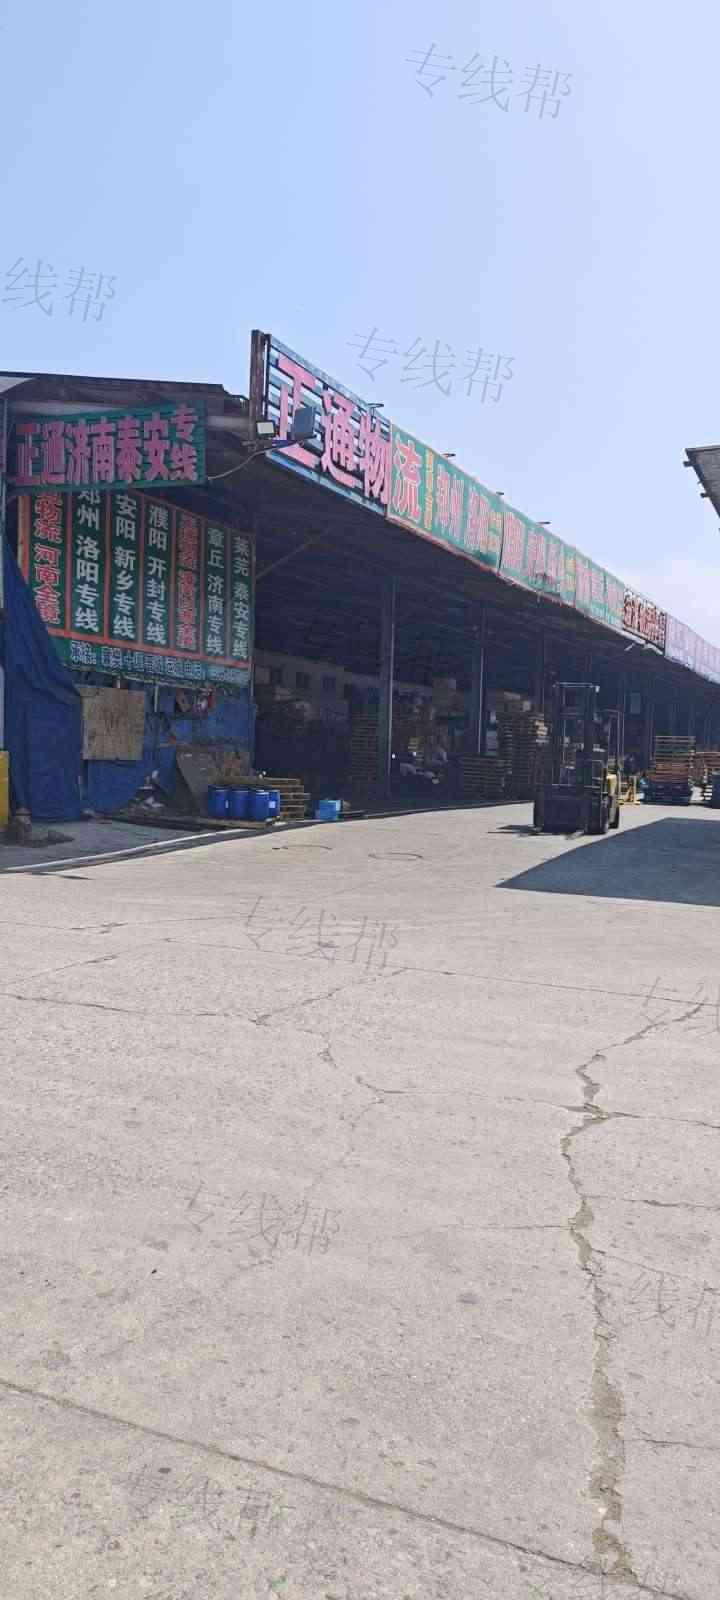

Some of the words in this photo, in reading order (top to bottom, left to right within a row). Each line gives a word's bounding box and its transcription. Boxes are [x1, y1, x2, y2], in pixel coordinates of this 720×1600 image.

[115, 494, 137, 541] 安阳
[148, 504, 169, 551] 濮阳
[75, 535, 100, 633] 洛阳专线
[113, 546, 136, 639] 新乡专线
[146, 556, 167, 645] 开封专线
[205, 574, 224, 657] 济南专线
[232, 581, 249, 660] 泰安专线
